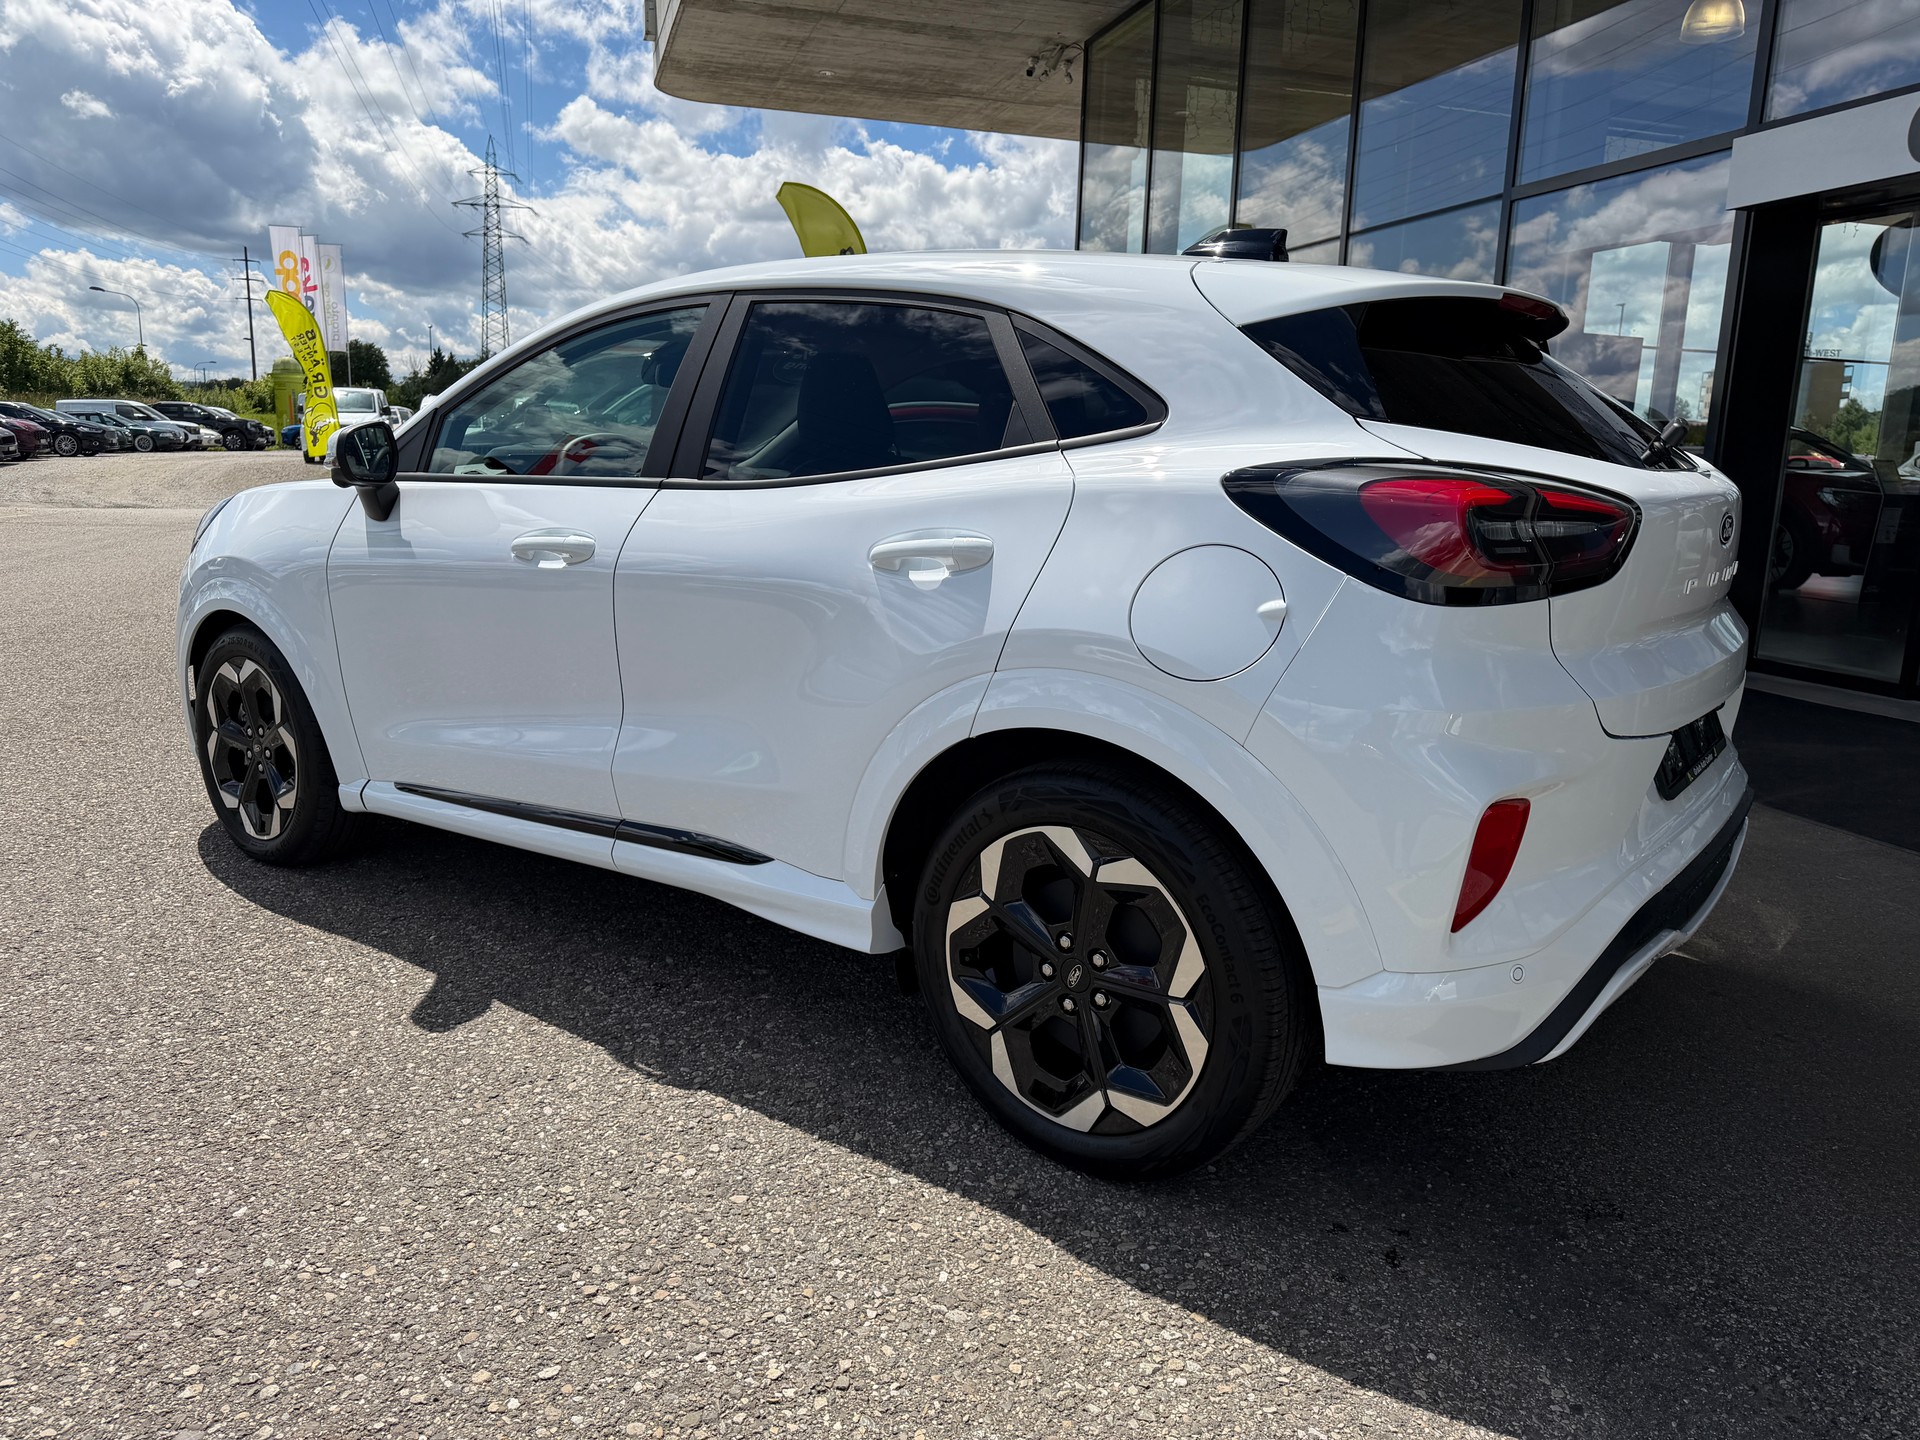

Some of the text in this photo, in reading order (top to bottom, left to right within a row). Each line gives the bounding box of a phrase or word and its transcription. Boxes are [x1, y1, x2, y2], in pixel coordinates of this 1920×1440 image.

[925, 815, 982, 906] Continental
[1196, 893, 1244, 1004] EcoContact 6
